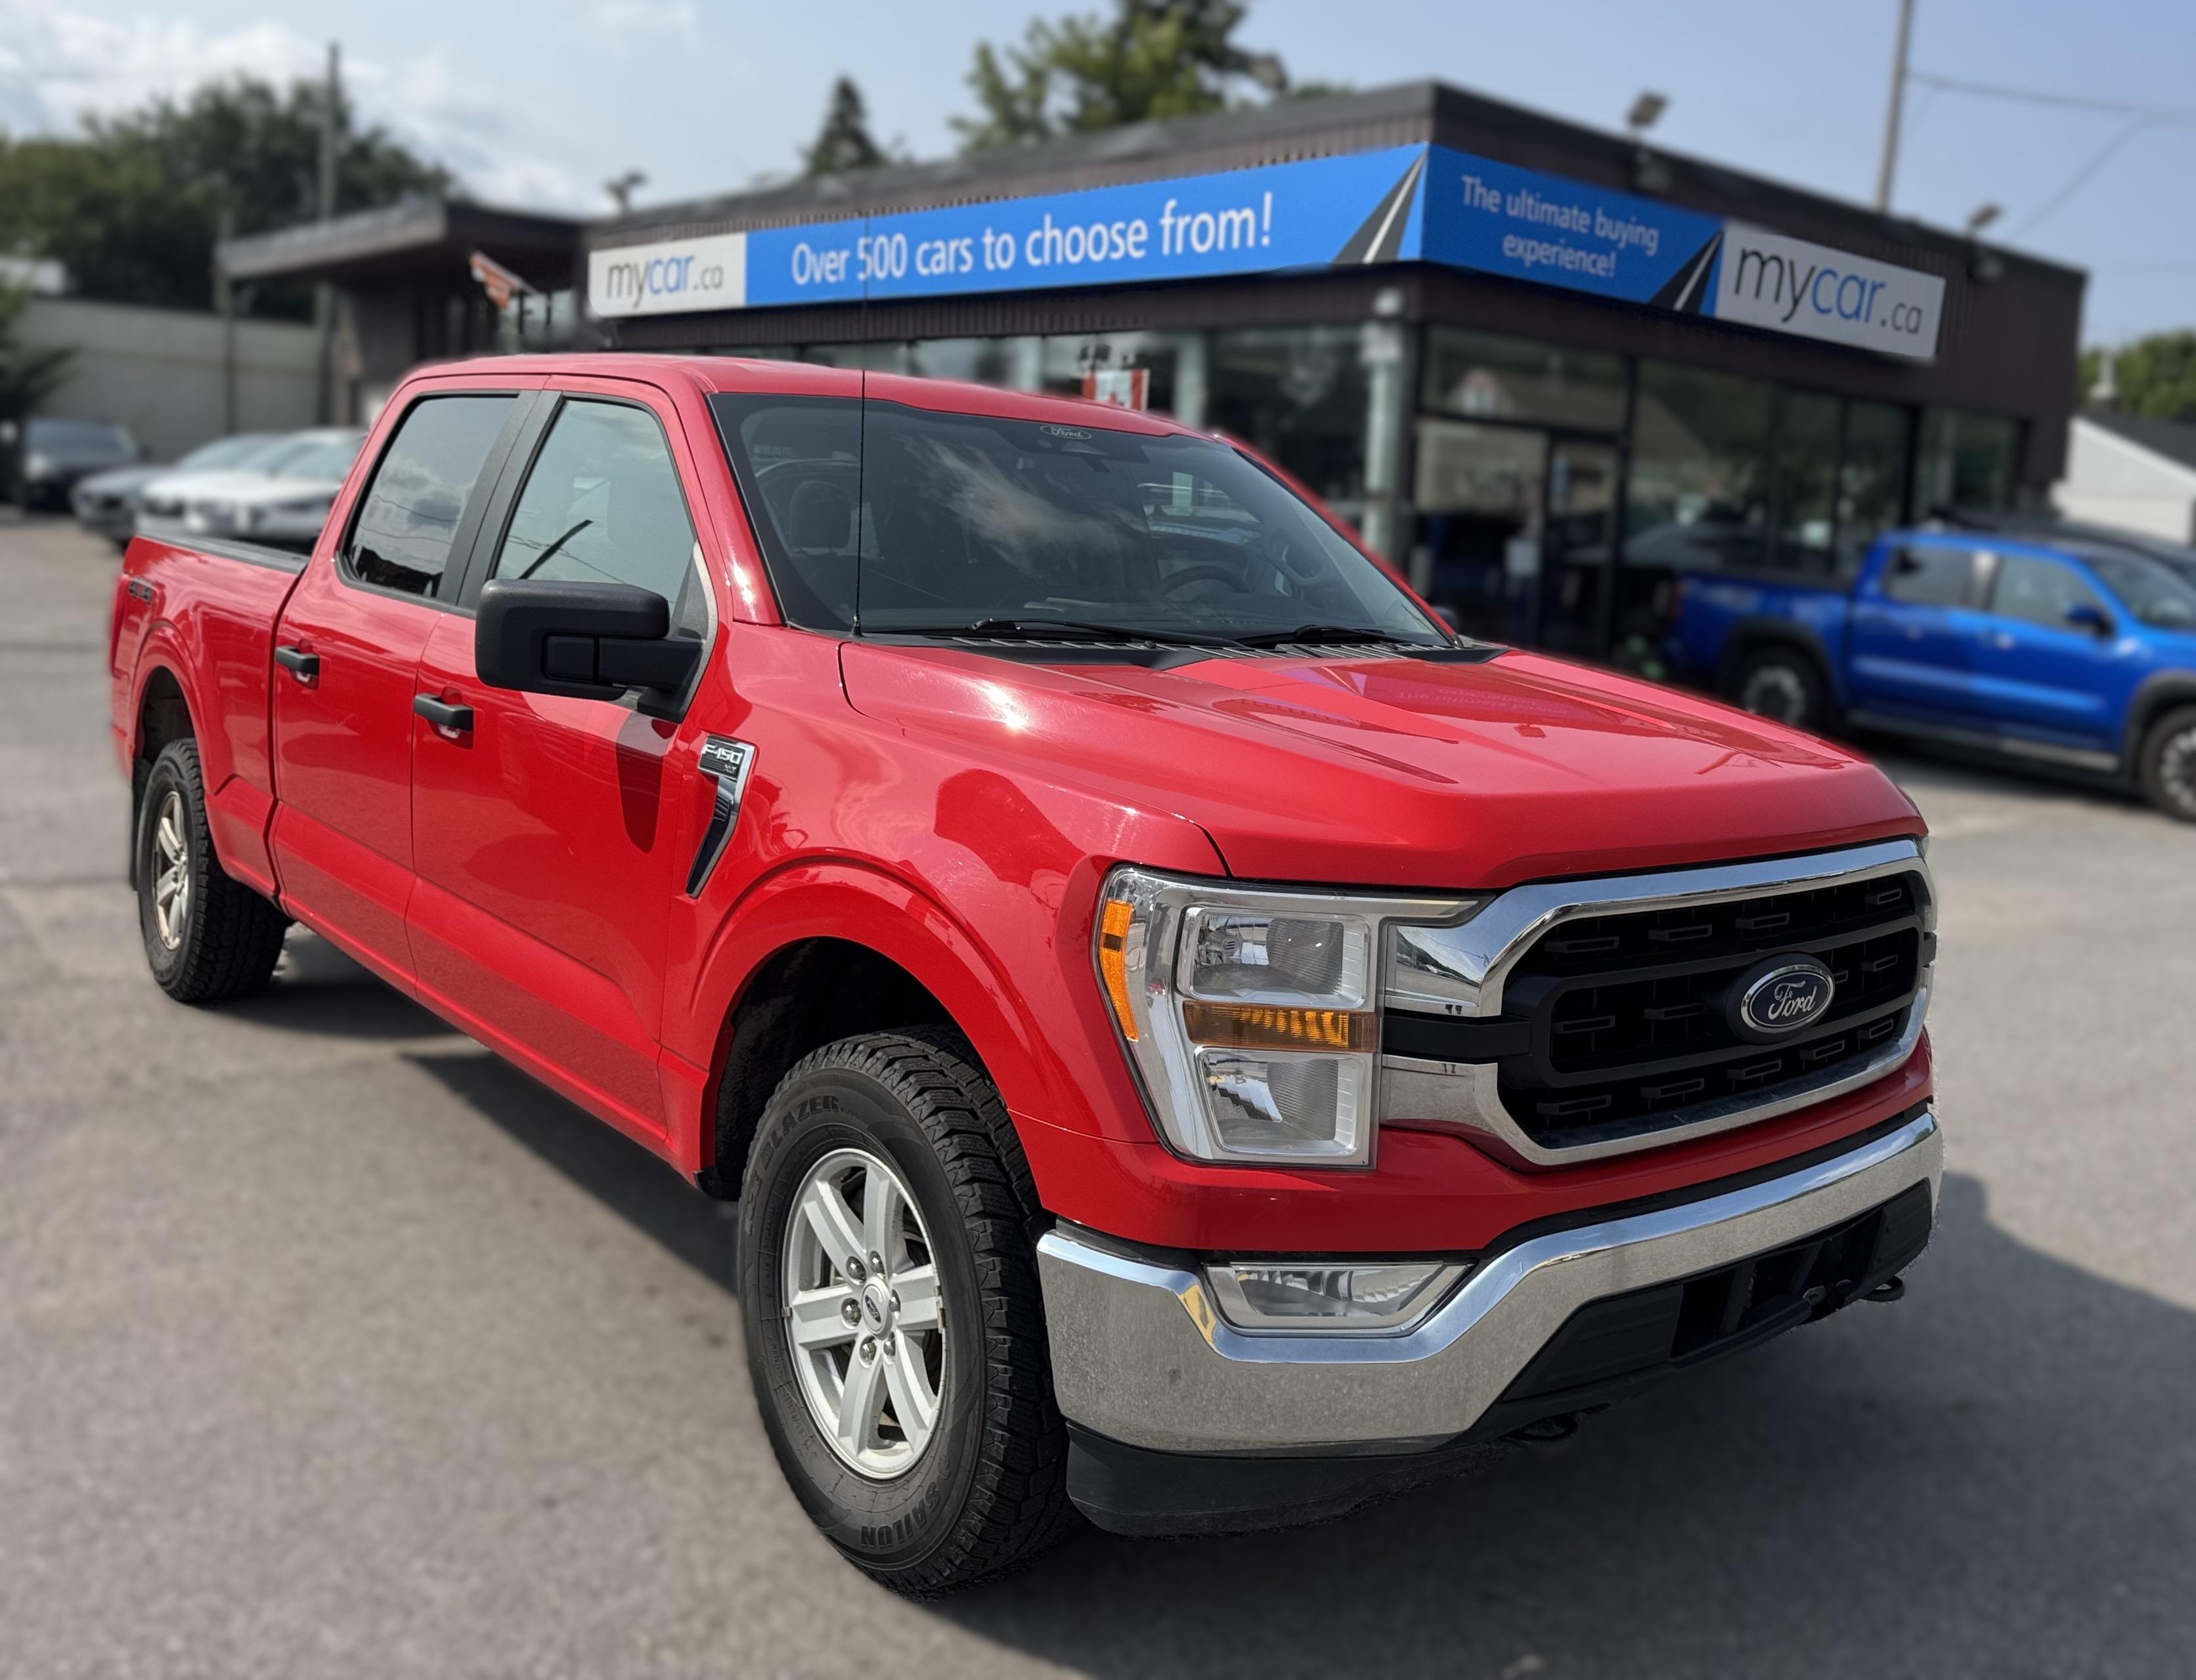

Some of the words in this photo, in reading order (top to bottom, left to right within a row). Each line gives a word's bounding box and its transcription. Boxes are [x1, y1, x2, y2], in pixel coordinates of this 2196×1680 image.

[791, 242, 850, 286] Over
[857, 232, 908, 282] 500
[915, 235, 974, 276] cars
[982, 226, 1015, 270] to
[1025, 213, 1149, 267] choose
[1159, 191, 1273, 257] from!
[1461, 175, 1501, 215] The
[1506, 186, 1592, 236] ultimate
[1594, 207, 1659, 255] buying
[605, 253, 724, 309] mycar.ca
[1502, 232, 1617, 278] experience!
[1734, 246, 1923, 335] mycar.ca
[1051, 427, 1084, 438] Ford
[1768, 980, 1817, 1020] Ford
[861, 1481, 940, 1550] SAILUN
